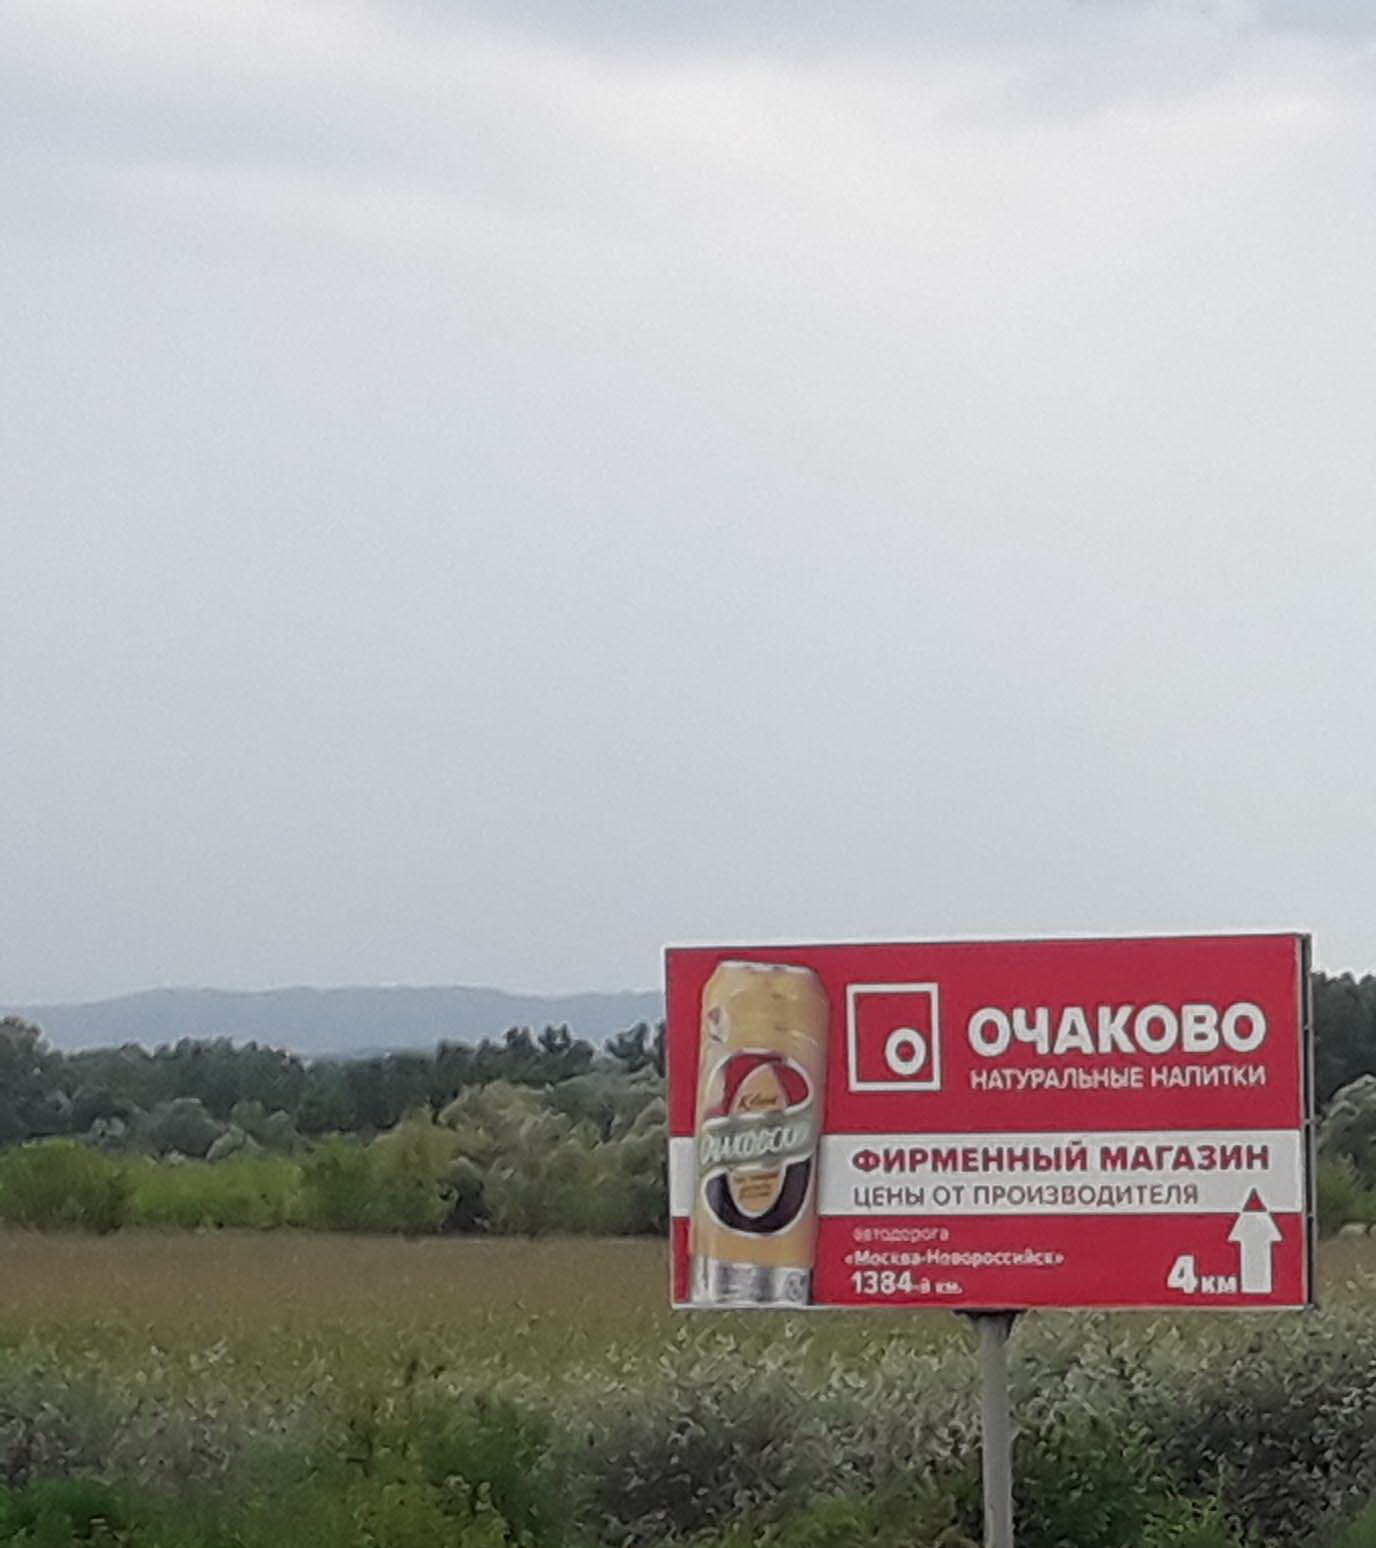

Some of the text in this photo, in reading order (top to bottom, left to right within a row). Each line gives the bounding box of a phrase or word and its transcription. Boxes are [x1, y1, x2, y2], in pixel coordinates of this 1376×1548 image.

[968, 1002, 1267, 1057] ОЧАКОВО
[970, 1064, 1267, 1091] НАТУРАЛЬНЫЕ НАПИТКИ
[852, 1140, 1270, 1173] ФИРМЕННЫЙ МАГАЗИН
[854, 1183, 1199, 1208] ЦЕНЫ ОТ ПРОИЗВОДИТЕЛЯ
